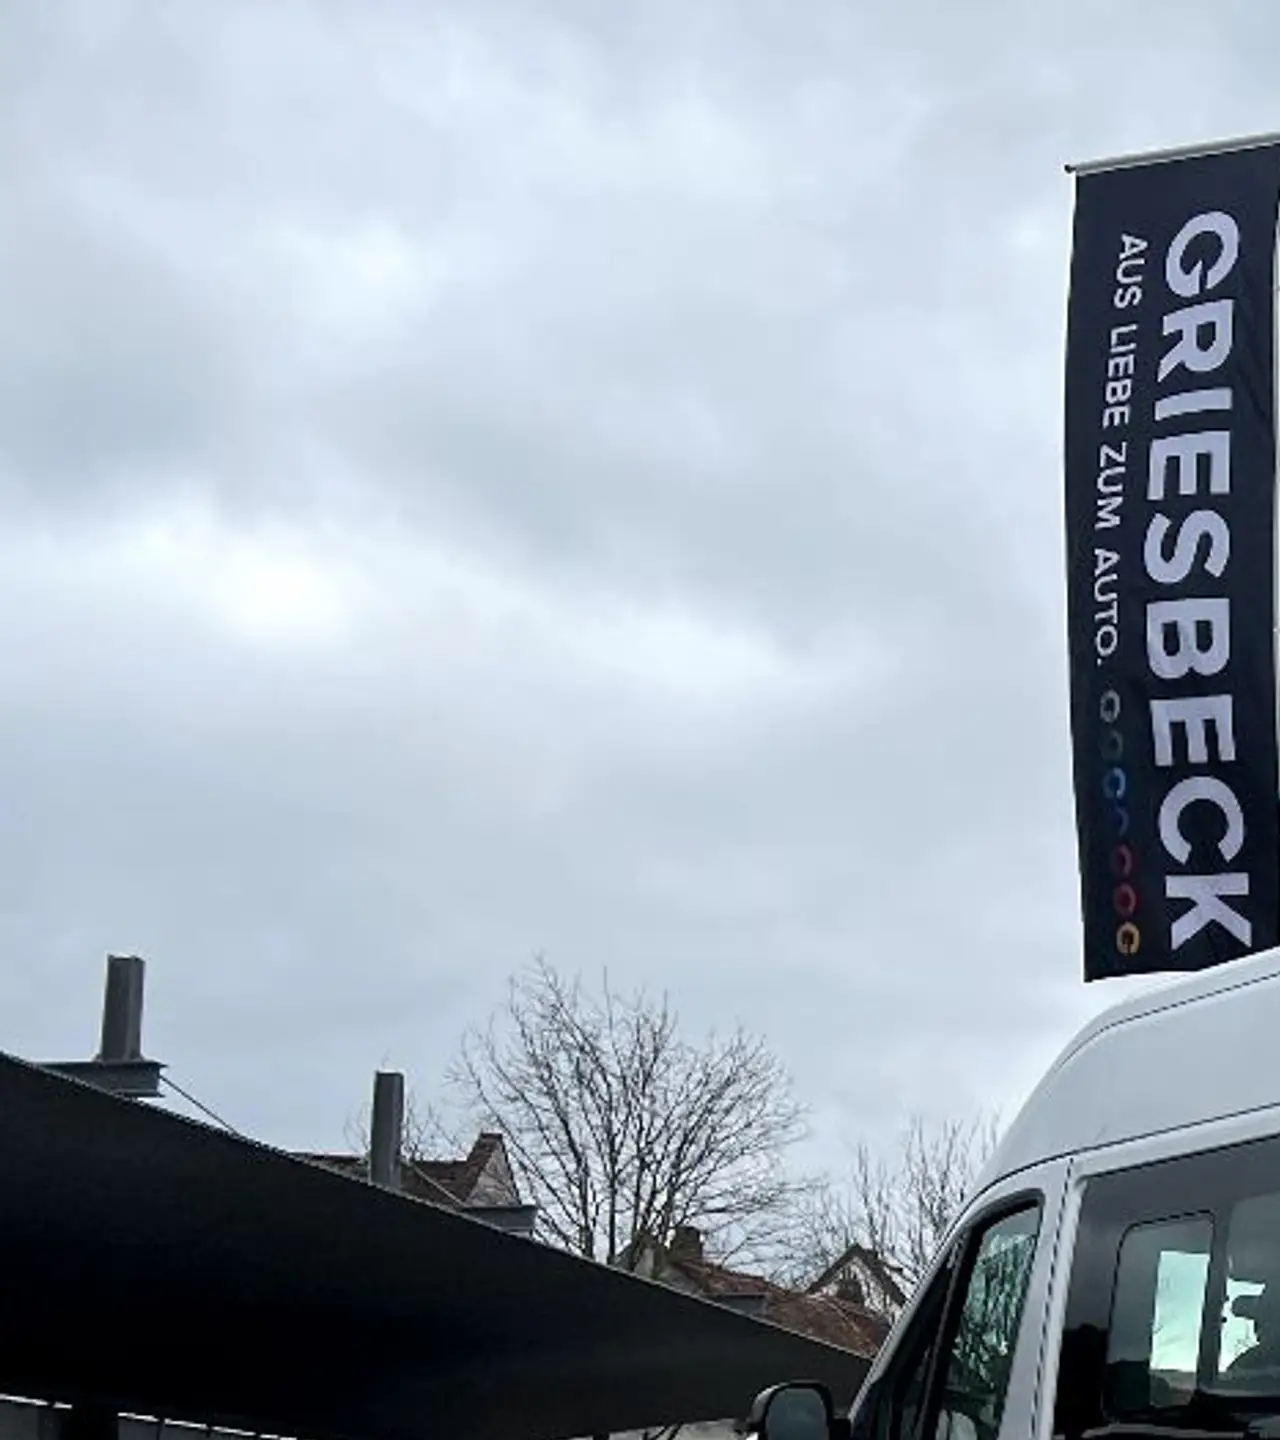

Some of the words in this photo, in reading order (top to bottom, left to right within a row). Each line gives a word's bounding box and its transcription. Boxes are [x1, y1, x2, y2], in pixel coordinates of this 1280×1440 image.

[1113, 232, 1148, 309] AUS
[1102, 323, 1138, 429] LIEBE
[1094, 440, 1127, 530] ZUM
[1093, 548, 1121, 667] AUTO.
[1143, 211, 1252, 951] GRIESBECK
